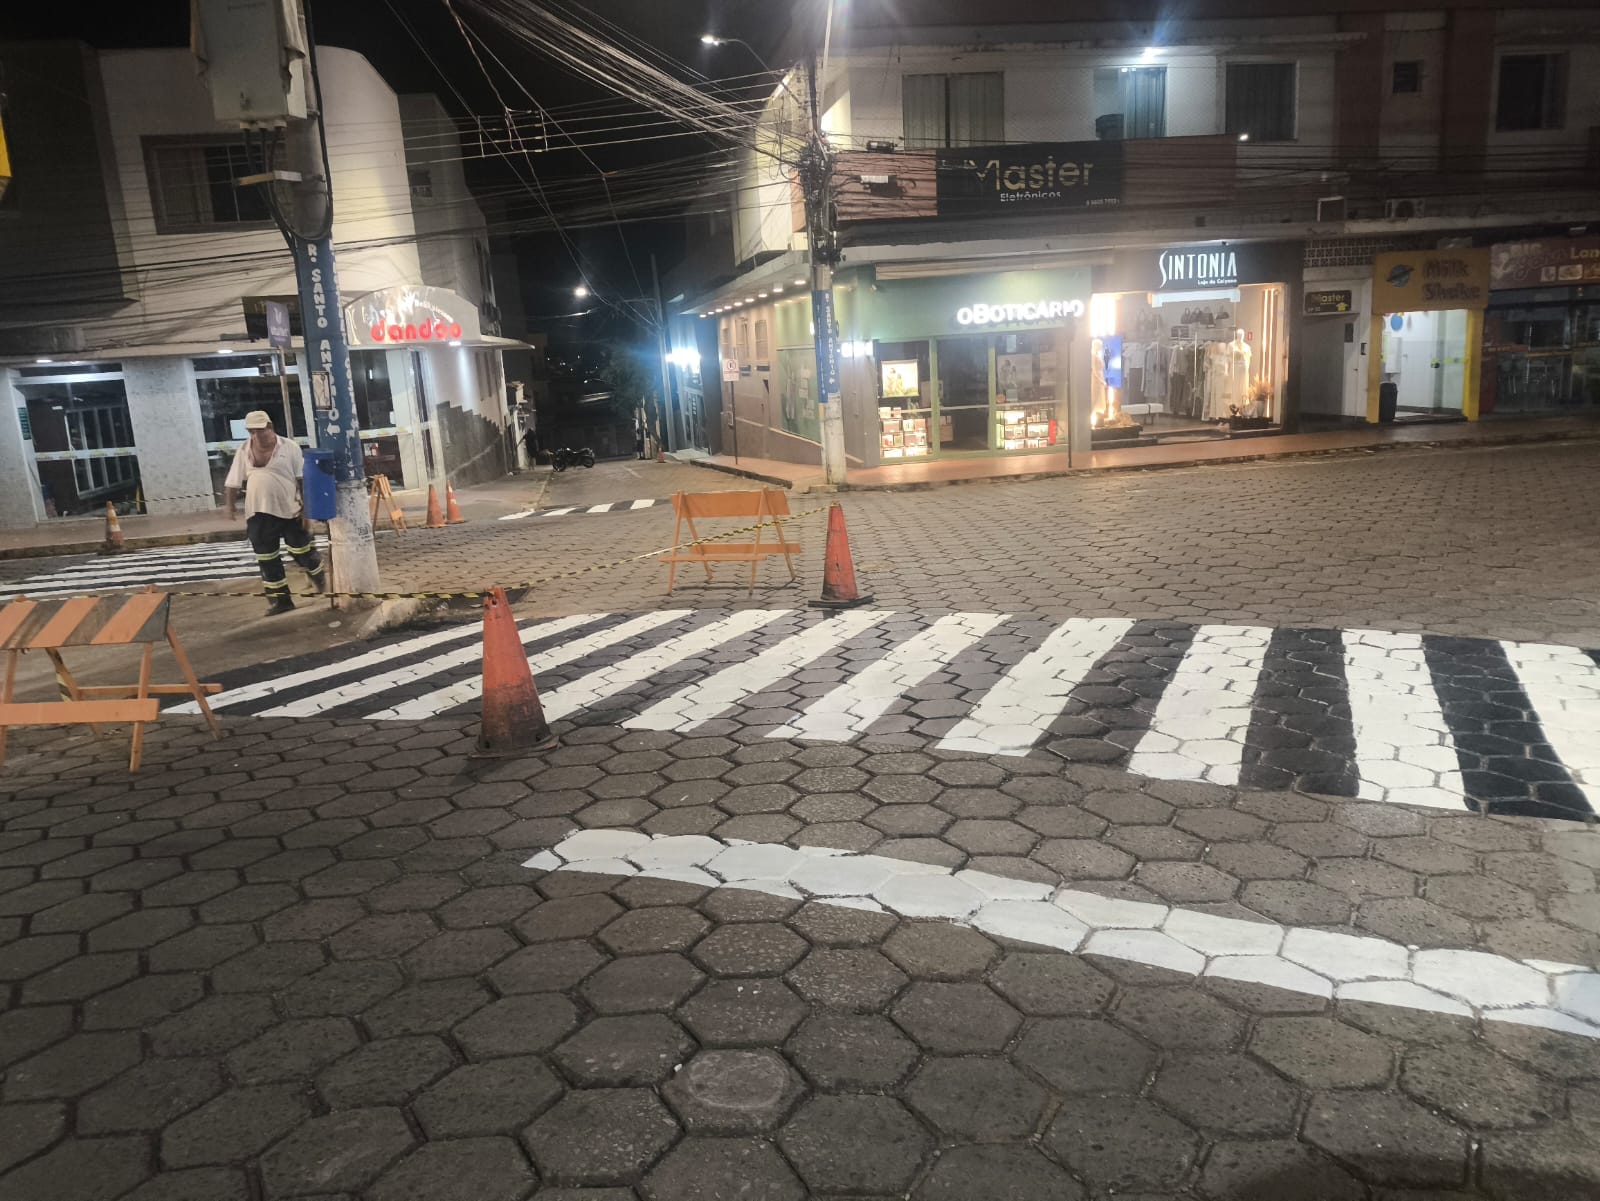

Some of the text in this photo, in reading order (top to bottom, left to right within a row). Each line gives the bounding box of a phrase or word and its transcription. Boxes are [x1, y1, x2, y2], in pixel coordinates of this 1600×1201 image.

[969, 156, 1094, 191] Master
[307, 243, 318, 263] R.
[1159, 250, 1238, 288] SINTONIA
[311, 268, 328, 329] SANTO
